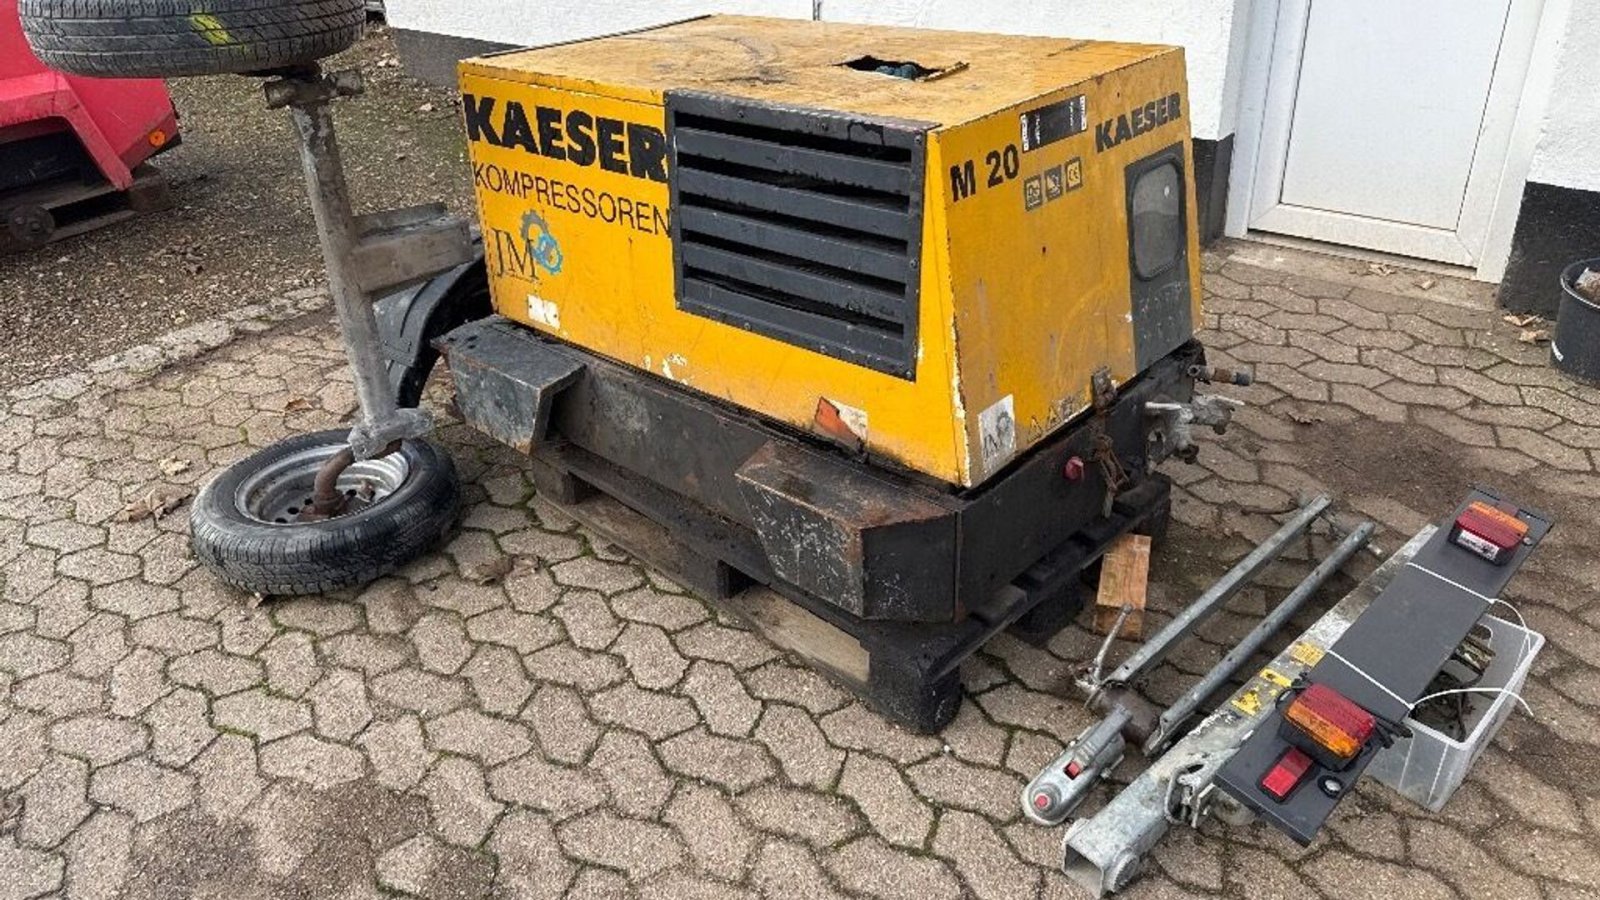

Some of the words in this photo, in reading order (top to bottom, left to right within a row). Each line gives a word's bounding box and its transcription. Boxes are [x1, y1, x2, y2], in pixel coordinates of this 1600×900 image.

[463, 94, 668, 183] KAESER
[1095, 92, 1181, 153] KAESER
[472, 161, 671, 238] KOMPRESSOREN
[950, 160, 976, 202] M
[986, 144, 1019, 188] 20
